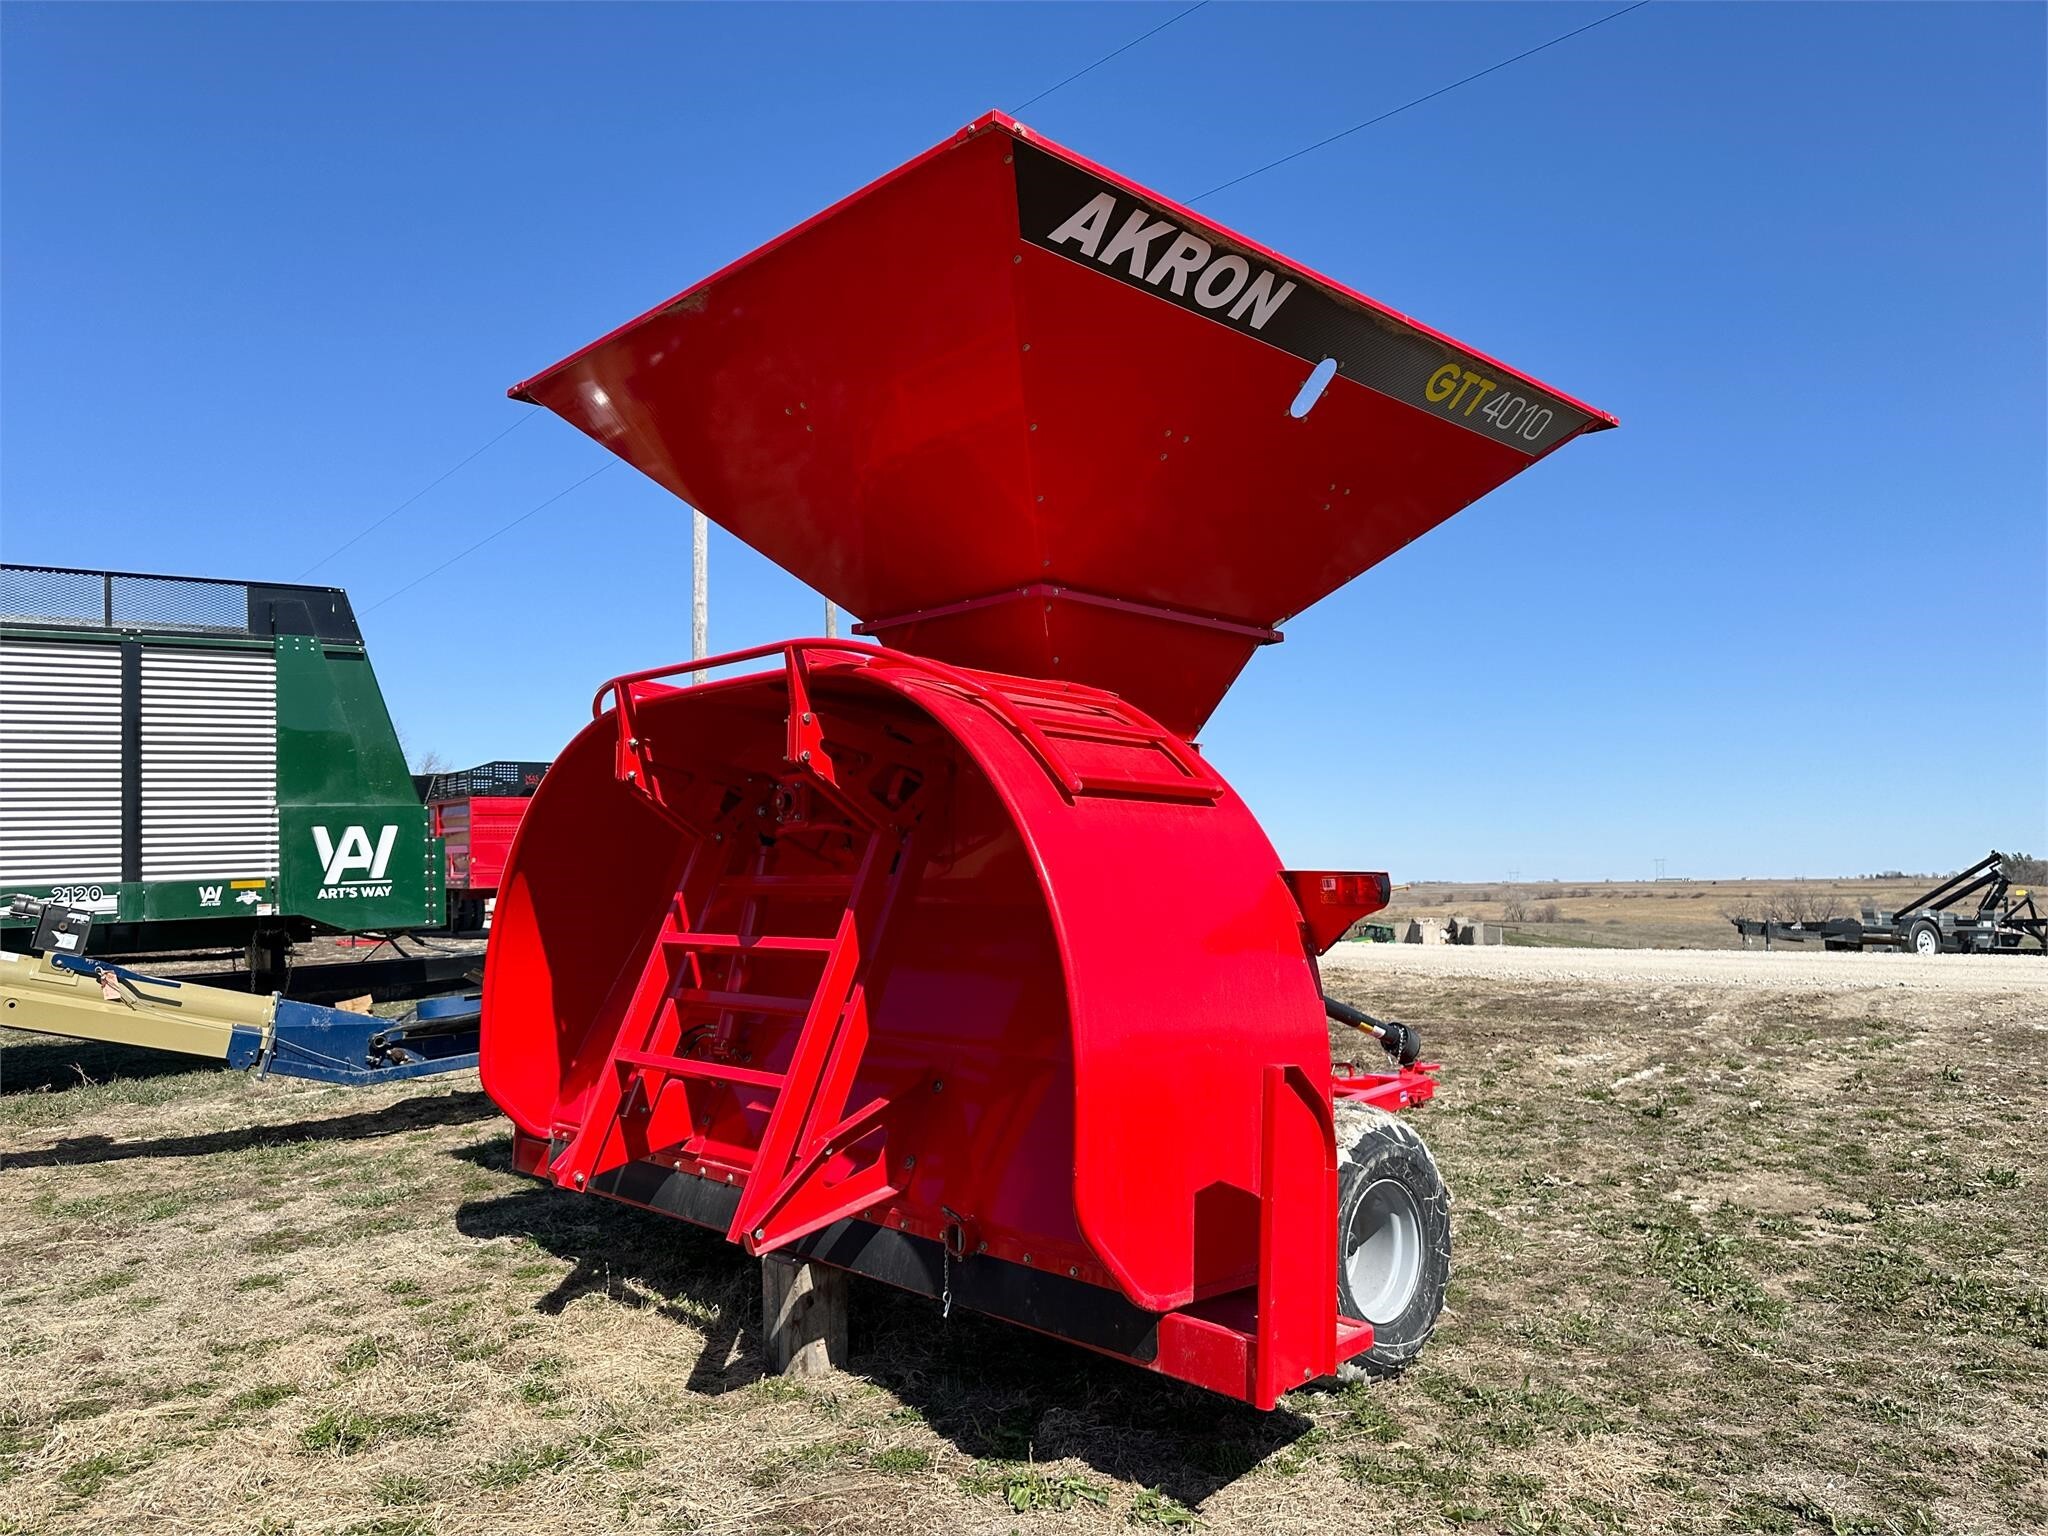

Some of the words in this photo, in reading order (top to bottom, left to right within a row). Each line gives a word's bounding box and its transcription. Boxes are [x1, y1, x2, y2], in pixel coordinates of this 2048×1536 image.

[1047, 192, 1297, 330] AKRON
[1425, 364, 1554, 442] GTT4010
[51, 885, 104, 904] 2120
[317, 887, 358, 899] ART'S
[360, 885, 392, 898] WAY
